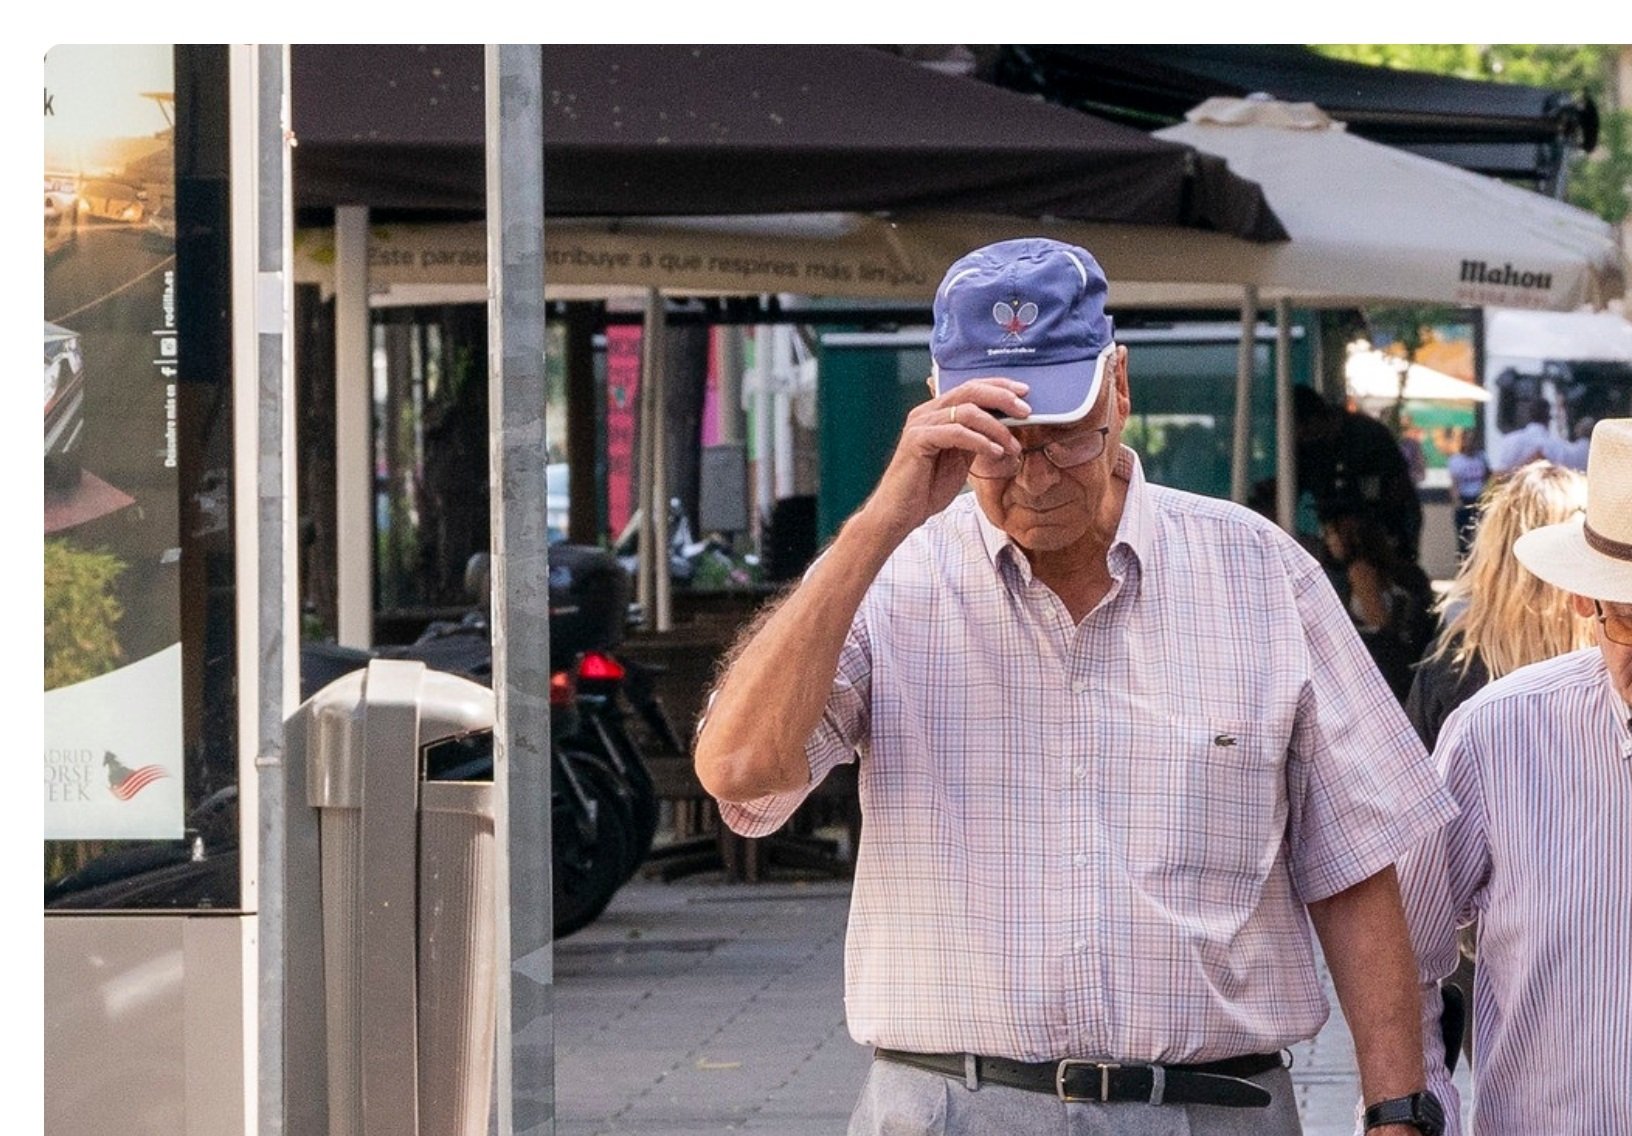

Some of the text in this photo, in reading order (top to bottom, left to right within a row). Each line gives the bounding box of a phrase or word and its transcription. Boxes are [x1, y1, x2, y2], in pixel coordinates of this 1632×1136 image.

[659, 254, 702, 273] que
[708, 256, 798, 277] respires
[1460, 260, 1552, 290] Mahou
[44, 749, 93, 763] DRID
[44, 765, 92, 782] ORSE
[49, 783, 91, 801] EEK
